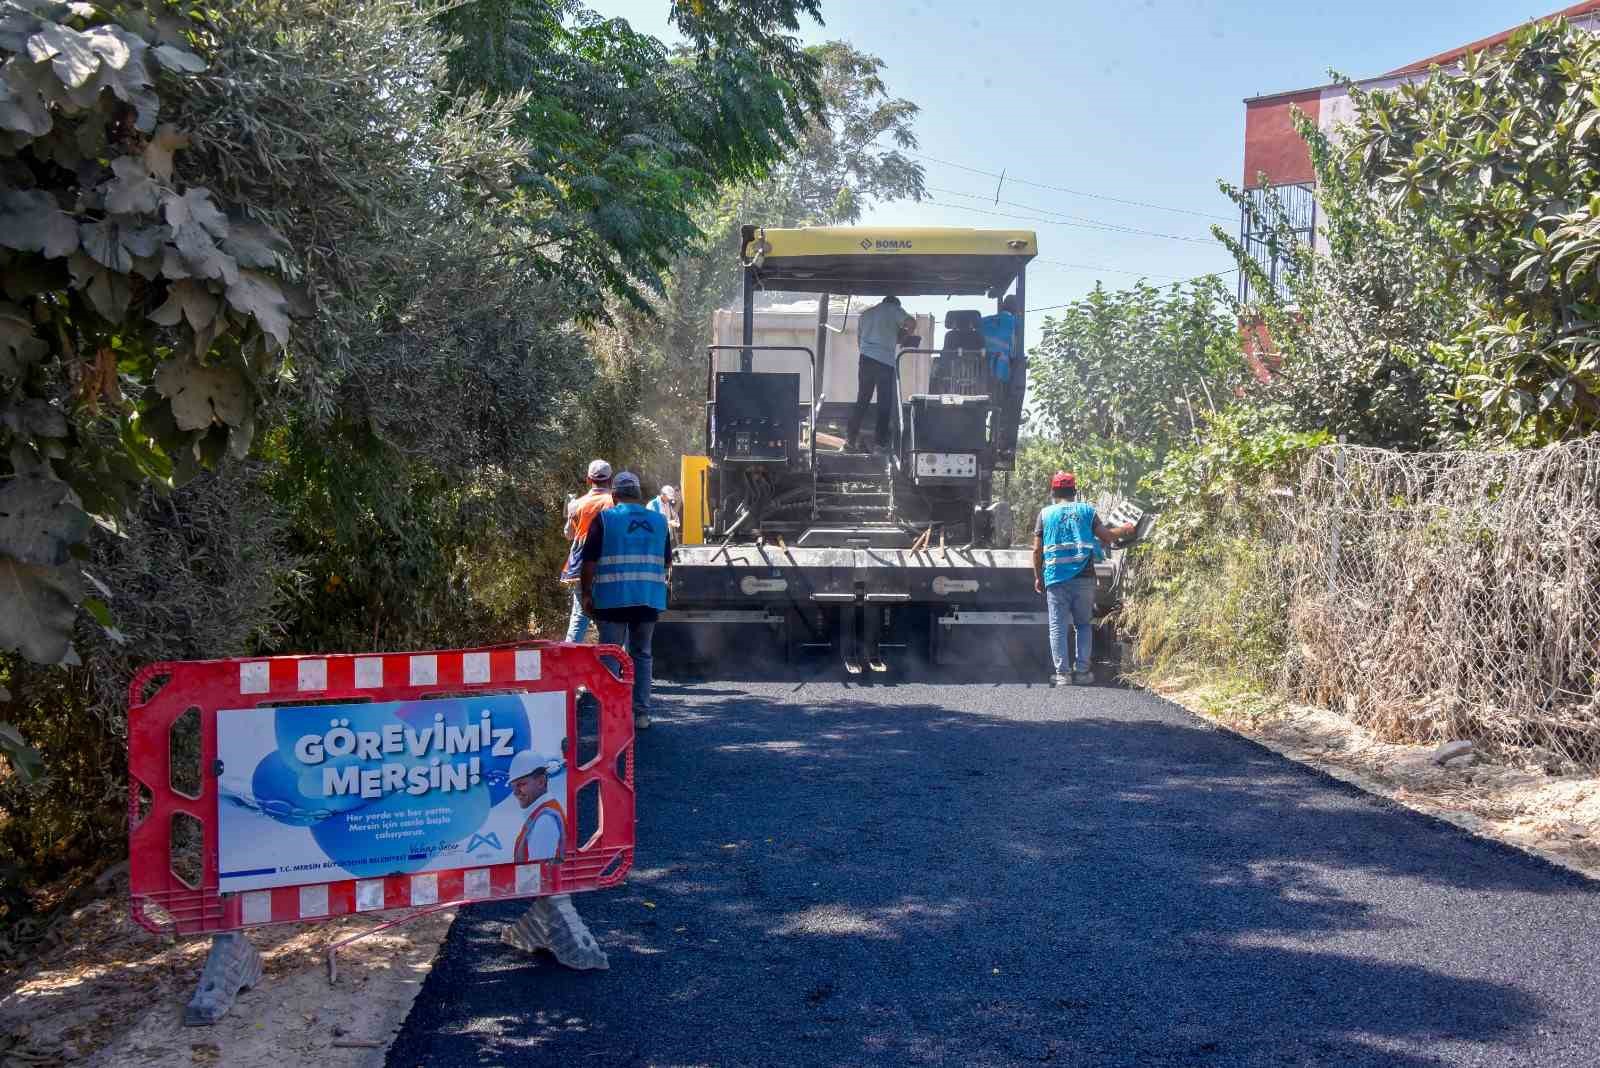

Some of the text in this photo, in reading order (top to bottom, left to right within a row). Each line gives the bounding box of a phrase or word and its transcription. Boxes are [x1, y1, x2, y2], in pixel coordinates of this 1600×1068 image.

[875, 240, 912, 249] BOMAG
[295, 709, 514, 764] GÖREVİMİZ
[322, 757, 481, 798] MERSİN!
